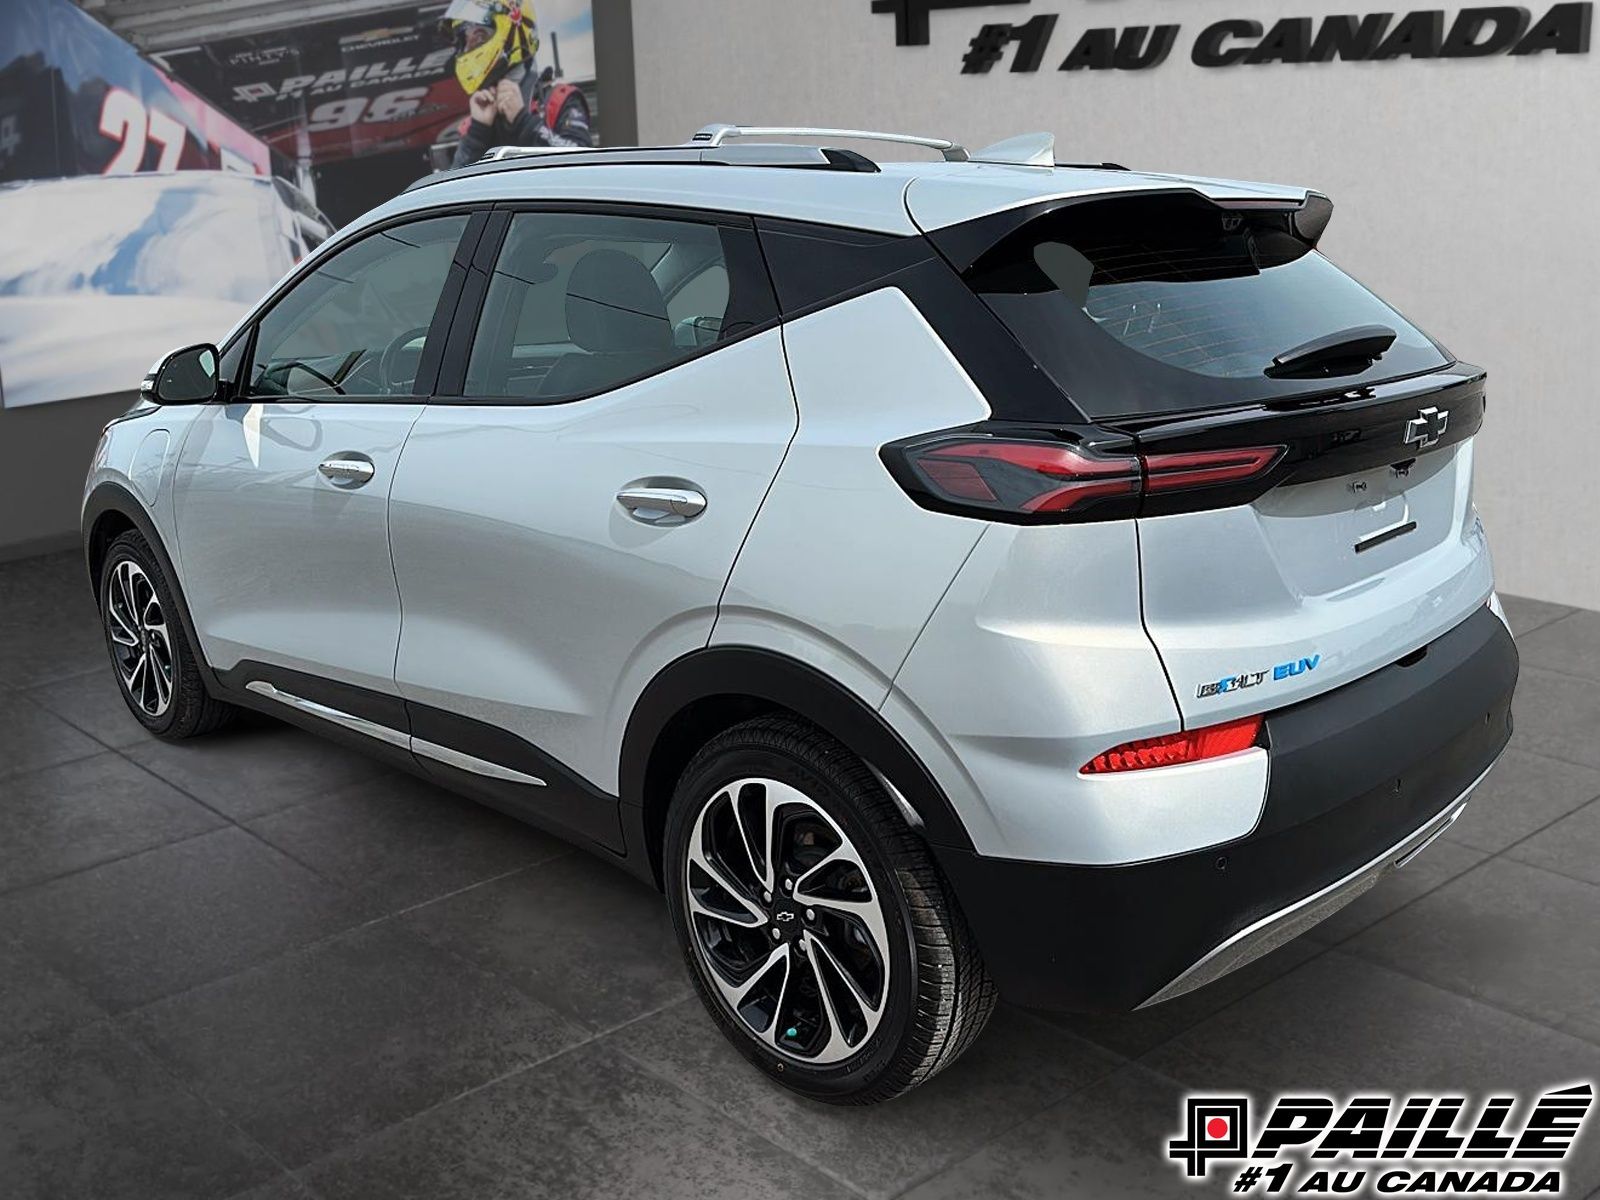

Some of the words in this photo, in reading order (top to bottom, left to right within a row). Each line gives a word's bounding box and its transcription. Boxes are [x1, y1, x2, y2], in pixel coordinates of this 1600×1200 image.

[341, 34, 419, 52] CHEVROLET
[960, 14, 1059, 75] #1
[1057, 24, 1181, 72] AU
[1190, 2, 1593, 68] CANADA
[350, 67, 445, 89] CANADA
[100, 86, 188, 177] 27
[307, 87, 430, 133] 96
[1196, 669, 1270, 698] BOLT
[1273, 654, 1320, 681] EUV
